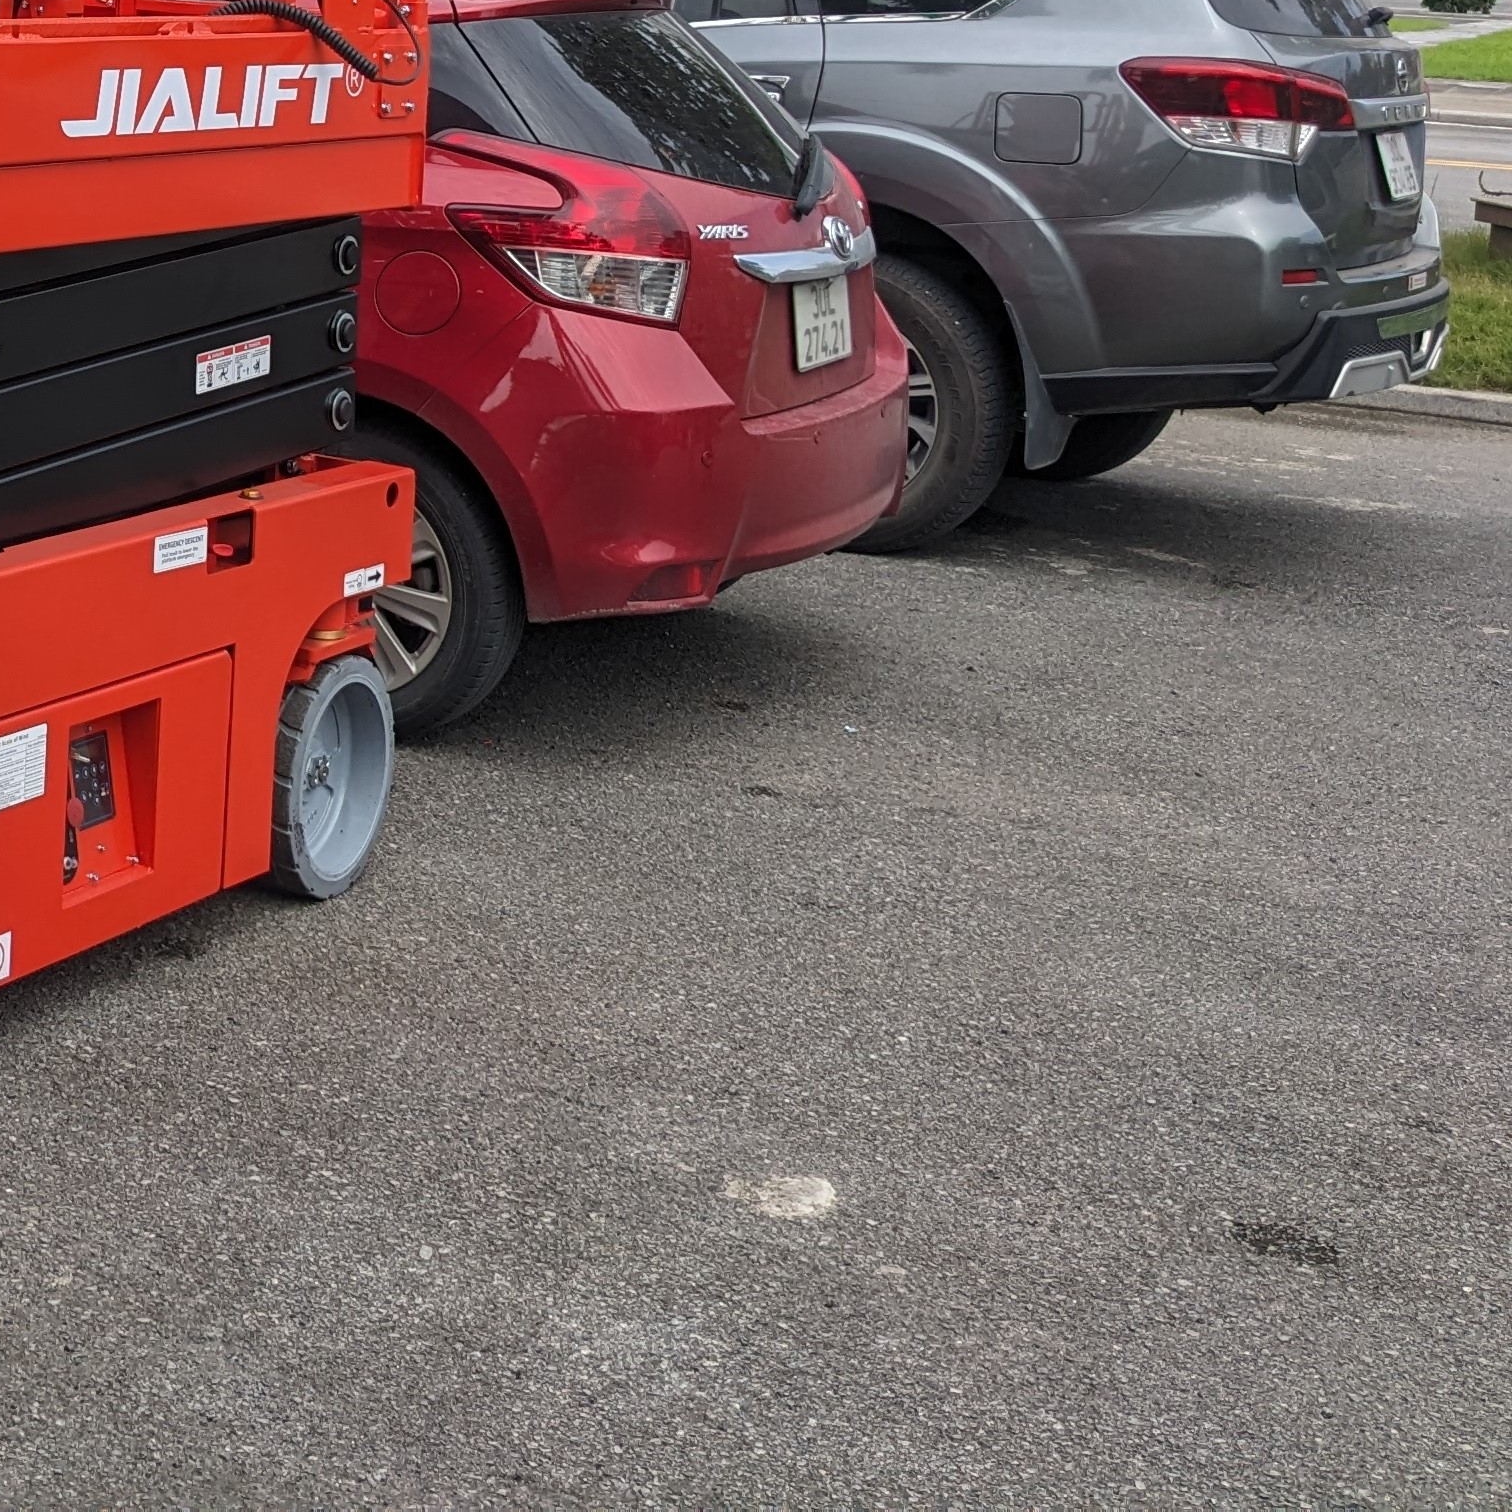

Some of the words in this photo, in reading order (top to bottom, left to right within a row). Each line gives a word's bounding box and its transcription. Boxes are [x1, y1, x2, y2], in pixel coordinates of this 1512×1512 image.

[60, 62, 344, 138] JIALIFT
[696, 224, 749, 240] YARIS
[159, 540, 185, 551] EMERGENCY
